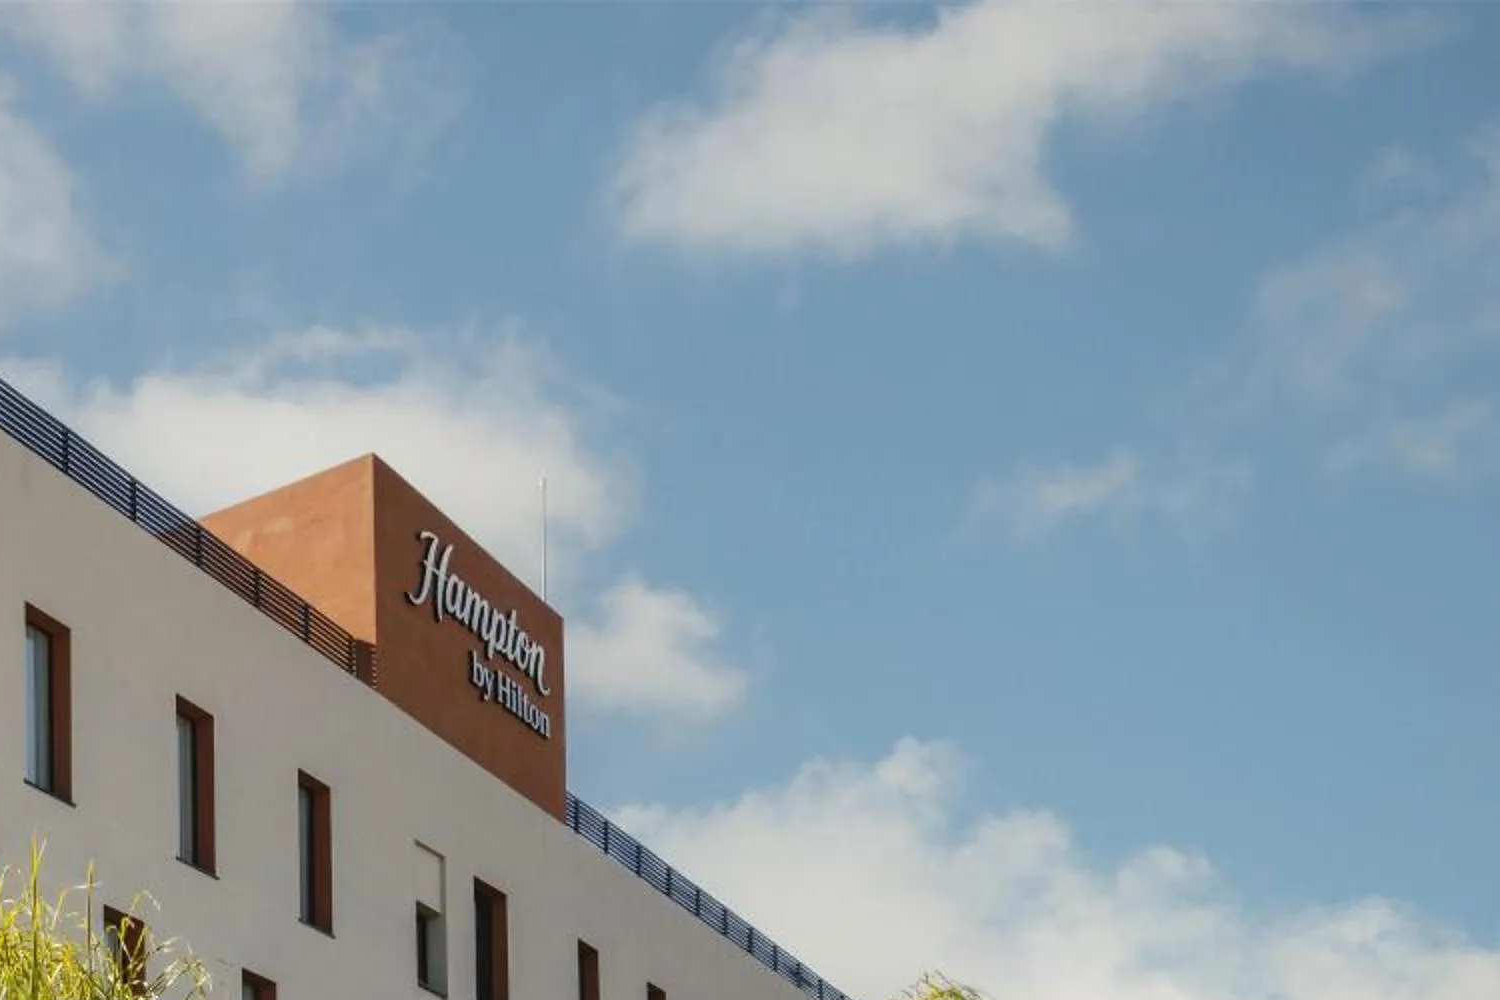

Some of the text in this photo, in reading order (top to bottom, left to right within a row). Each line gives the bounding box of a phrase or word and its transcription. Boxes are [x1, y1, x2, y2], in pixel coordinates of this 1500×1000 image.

[406, 530, 550, 695] Hampton
[470, 650, 551, 738] by Hilton
